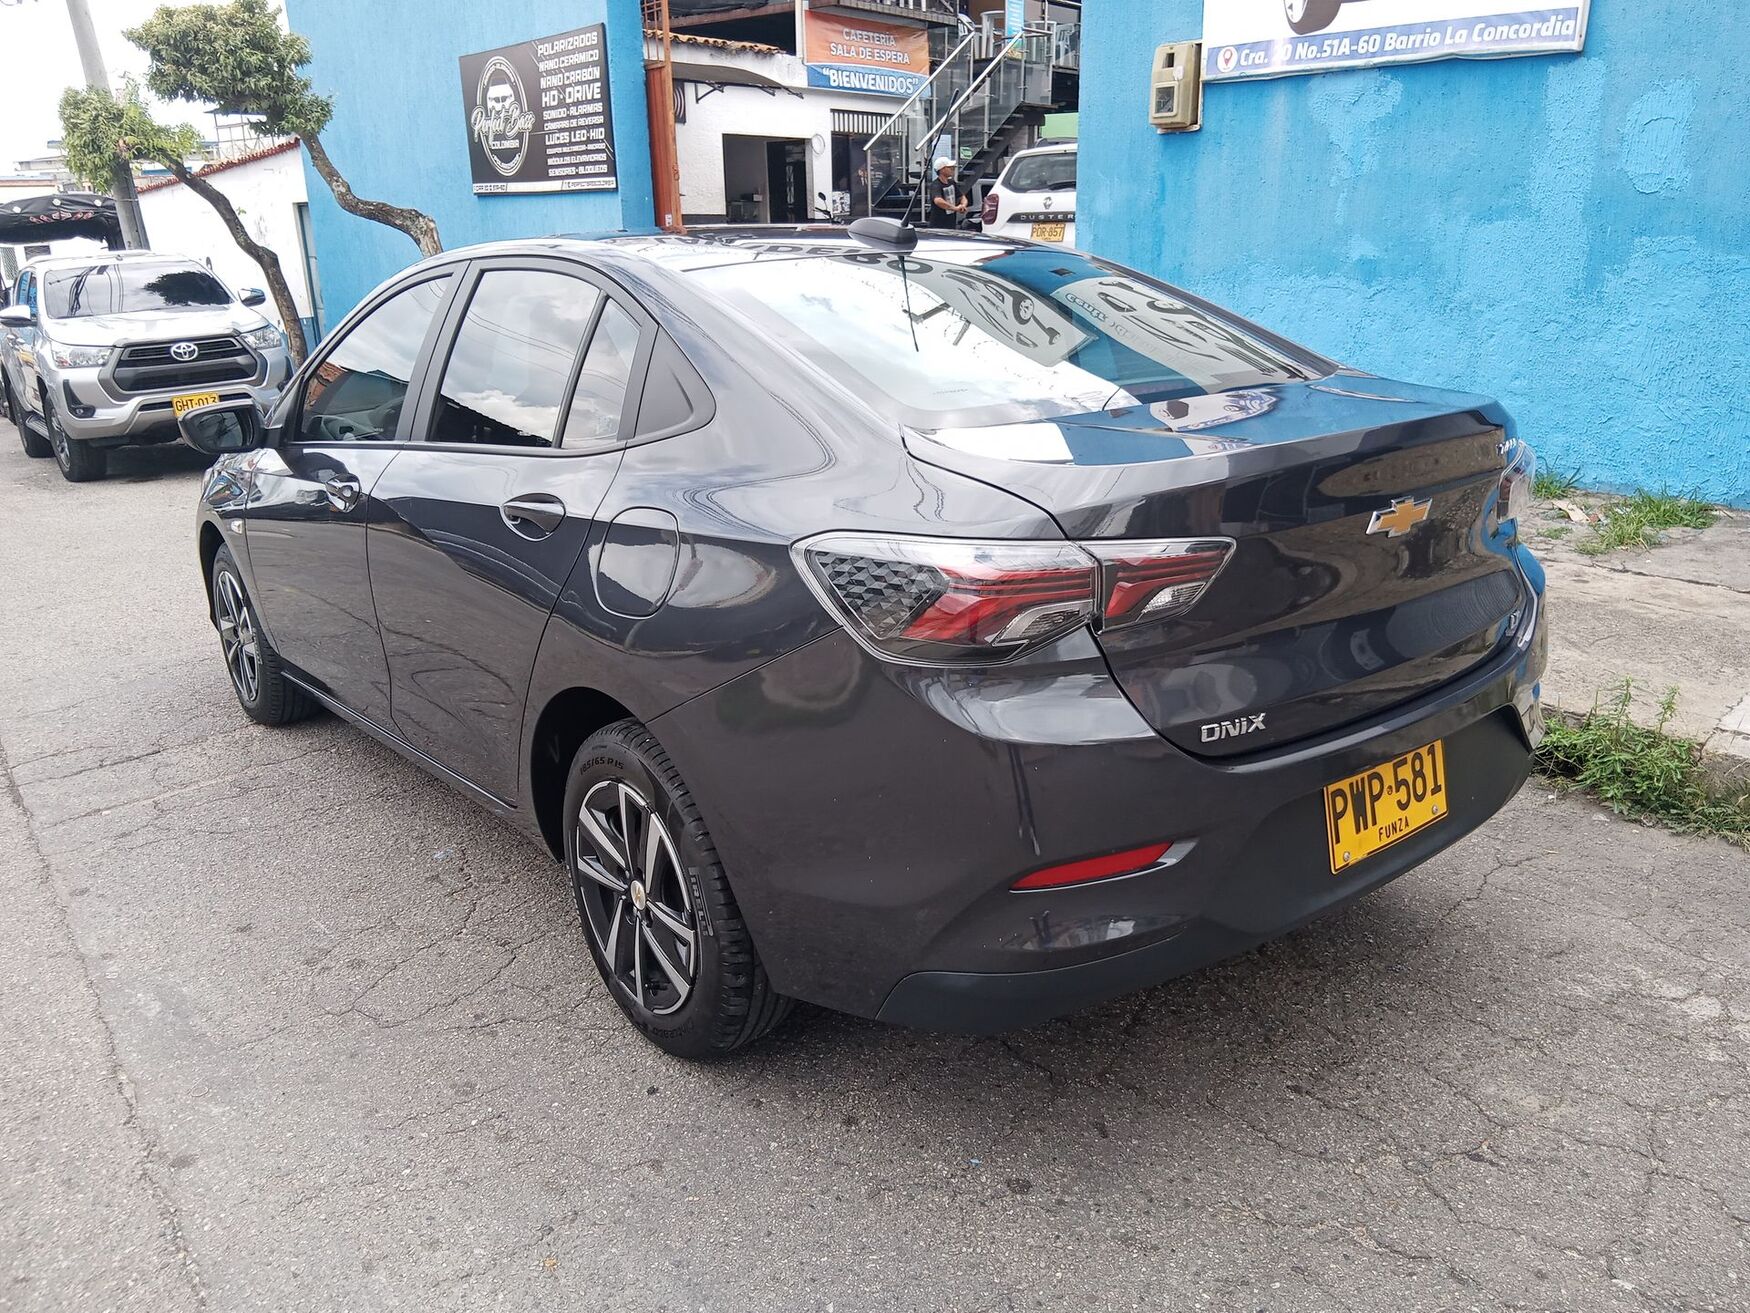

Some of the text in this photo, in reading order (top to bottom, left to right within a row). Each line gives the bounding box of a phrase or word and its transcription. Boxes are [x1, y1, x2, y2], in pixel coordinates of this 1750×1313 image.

[537, 31, 598, 57] POLARIZADOS
[1238, 15, 1577, 68] Cra. 0 No.51A-60 Barrio La Concordia
[830, 42, 910, 65] SALA DE ESPERA
[540, 73, 563, 89] NANO
[565, 82, 601, 104] DRIVE
[545, 131, 569, 145] LUCES
[1020, 213, 1074, 221] DUSTER
[1377, 815, 1410, 843] FUNZA
